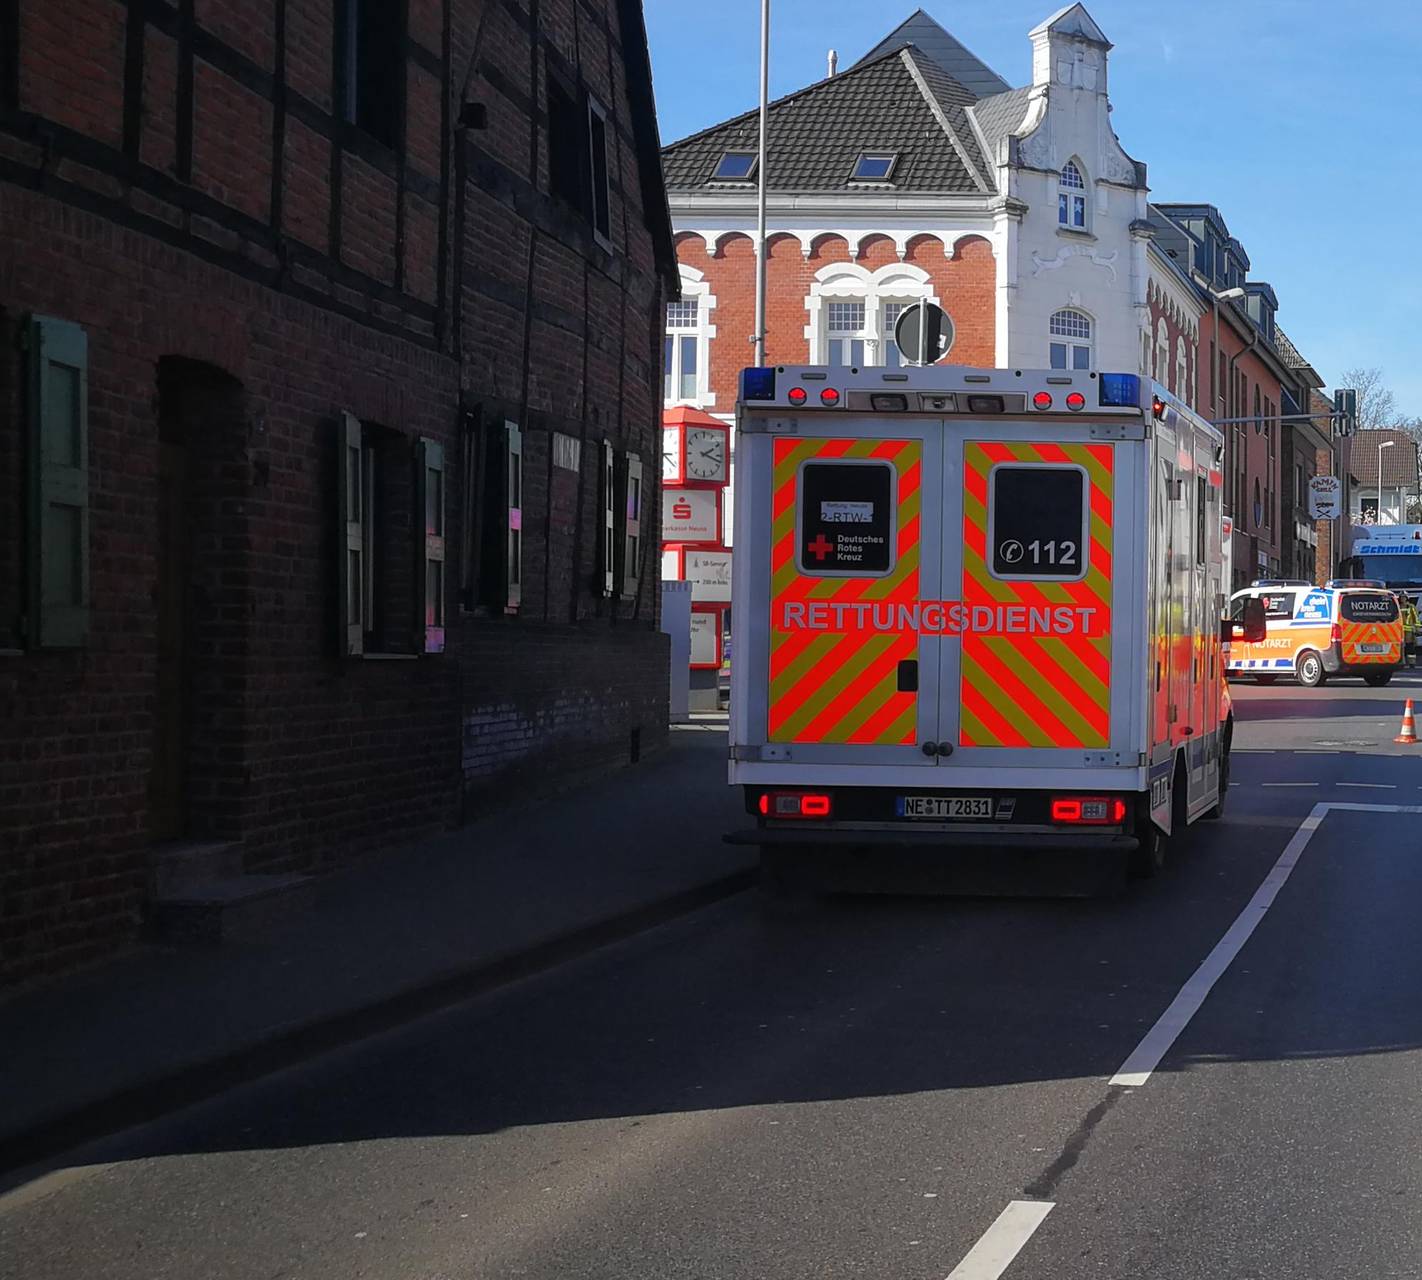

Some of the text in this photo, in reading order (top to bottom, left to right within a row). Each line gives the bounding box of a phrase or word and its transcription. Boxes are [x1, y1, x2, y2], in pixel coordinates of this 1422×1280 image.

[838, 535, 884, 543] Deutsches
[838, 544, 863, 552] Rotes
[1028, 540, 1076, 565] 112
[1360, 545, 1420, 554] Schmidt
[838, 553, 862, 561] Kreuz
[1351, 601, 1390, 610] NOTARZT
[783, 602, 1096, 634] RETTUNGSDIENST
[906, 799, 924, 815] NE
